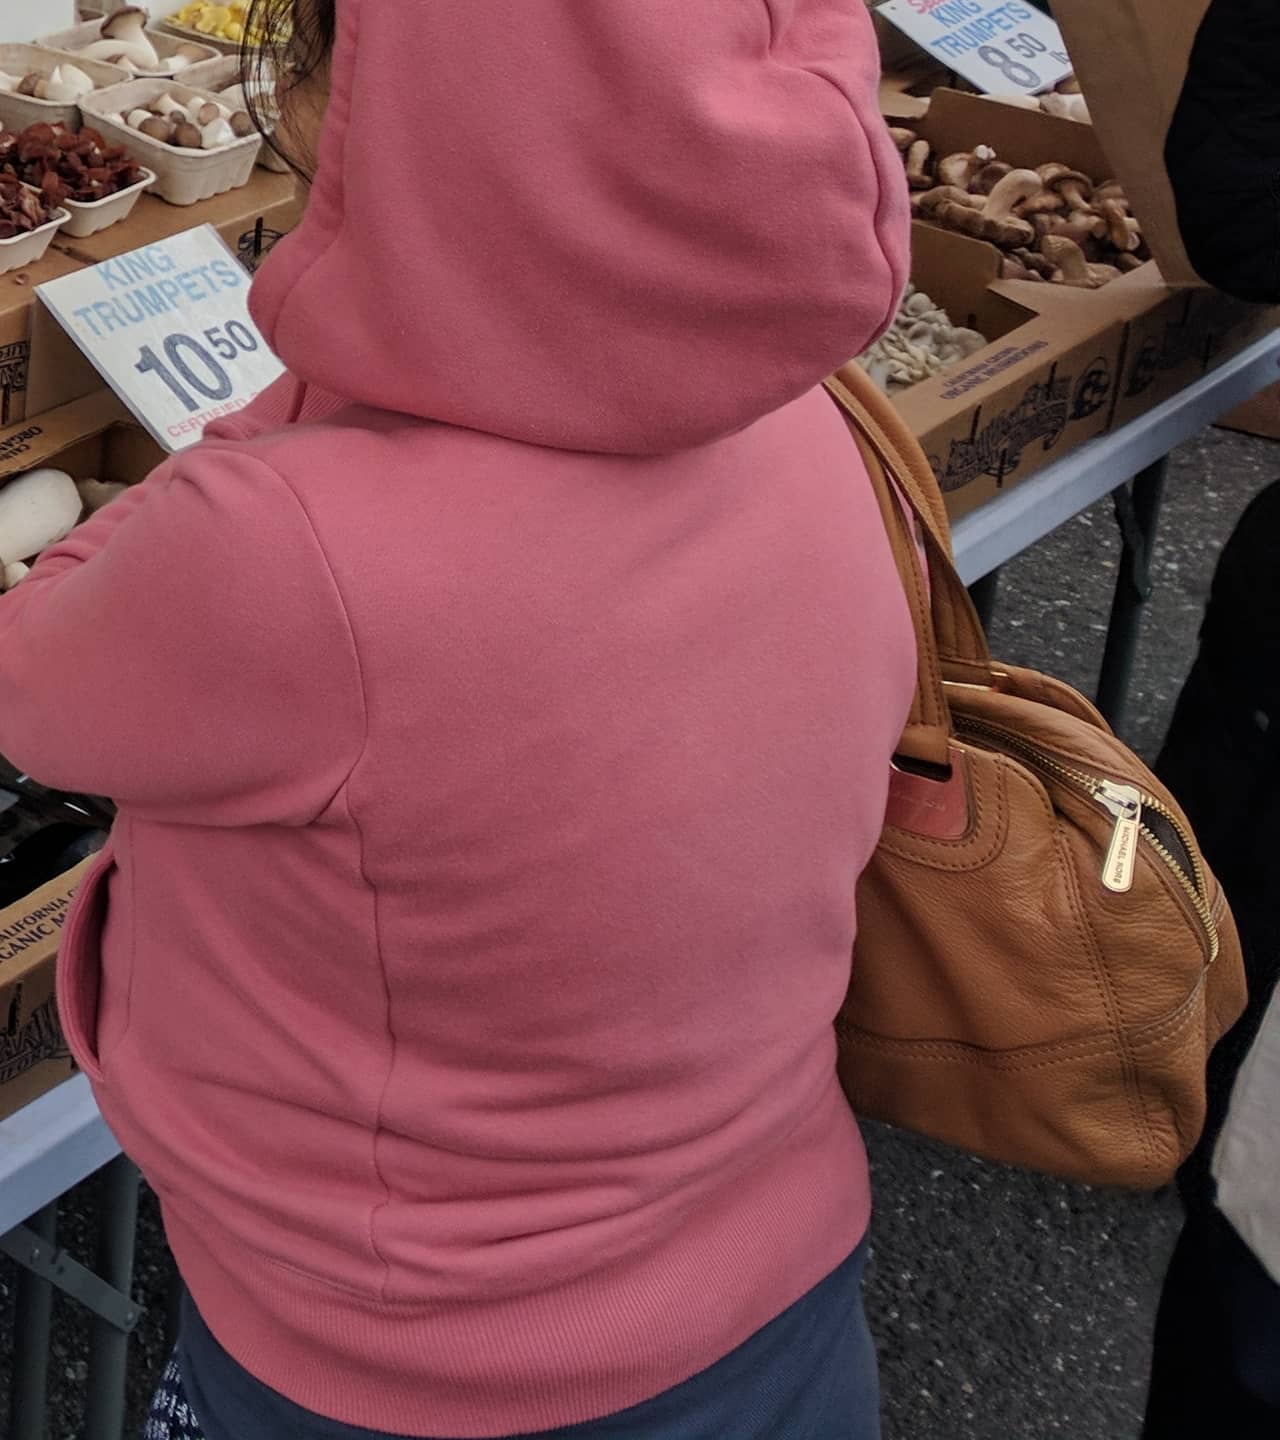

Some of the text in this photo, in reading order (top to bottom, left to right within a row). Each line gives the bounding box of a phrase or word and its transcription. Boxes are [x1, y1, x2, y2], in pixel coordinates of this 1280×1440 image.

[930, 2, 1032, 58] TRUMPETS
[95, 245, 175, 291] KING
[73, 260, 242, 338] TRUMPETS
